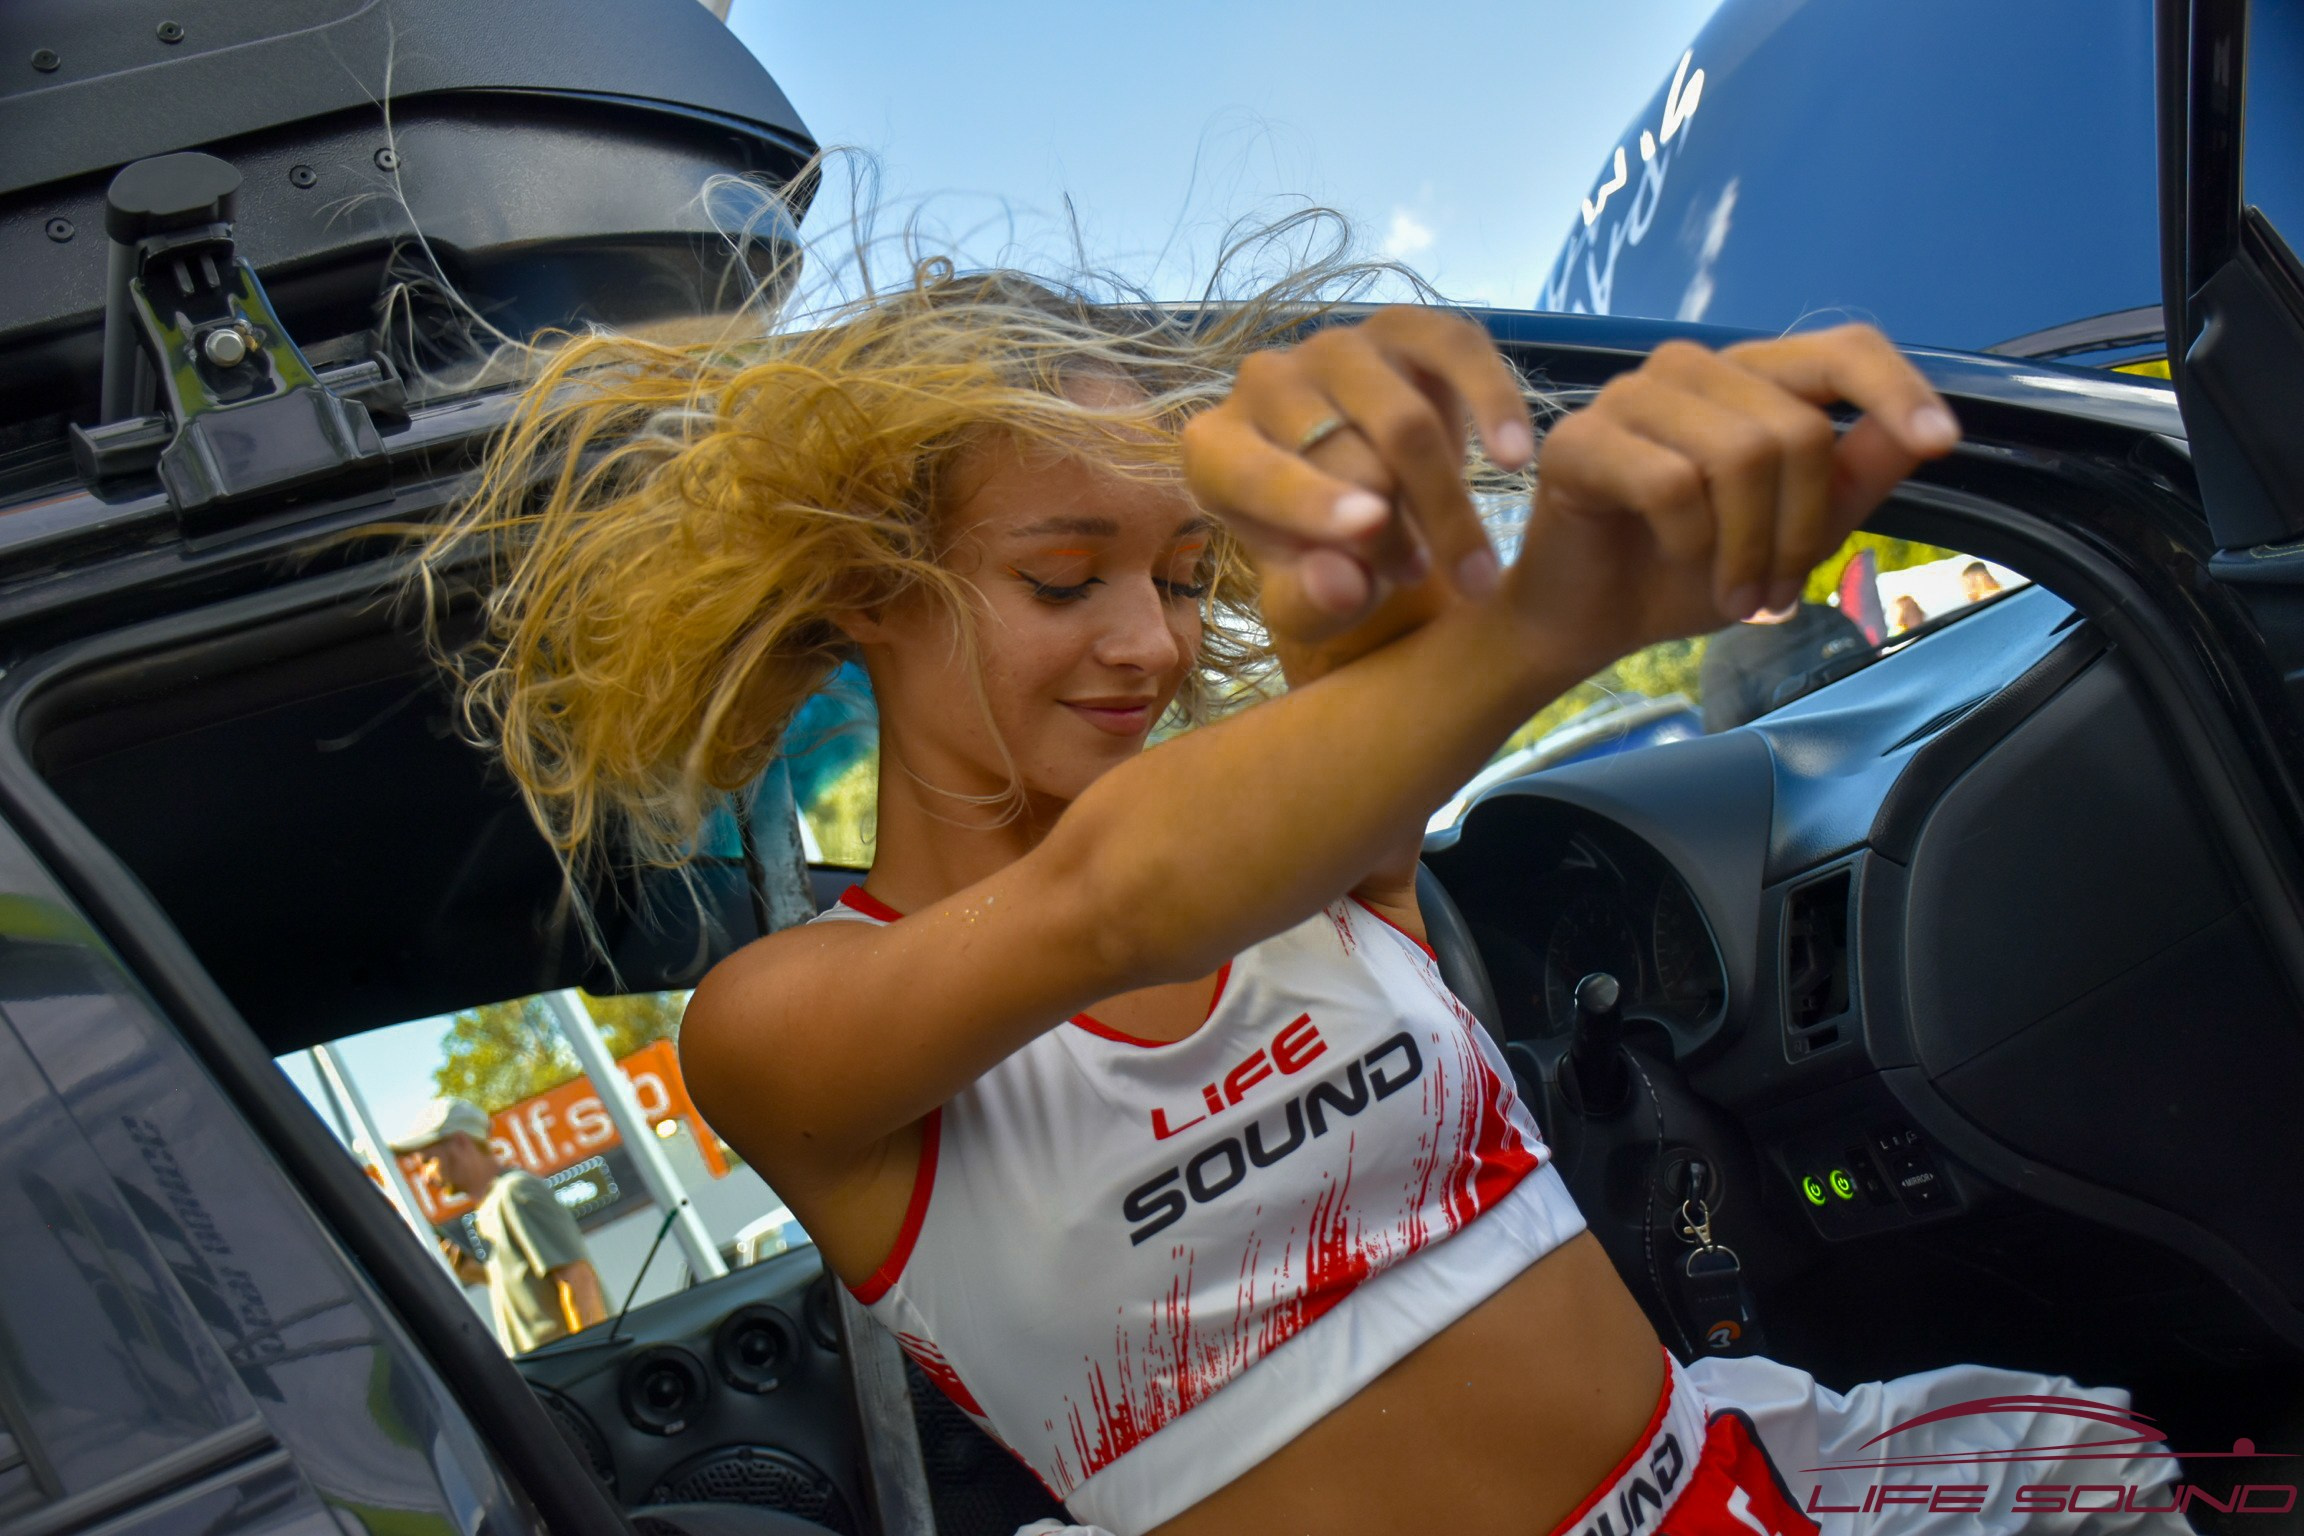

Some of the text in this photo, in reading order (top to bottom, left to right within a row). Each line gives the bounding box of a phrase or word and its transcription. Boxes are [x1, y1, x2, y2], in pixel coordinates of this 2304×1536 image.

[1123, 1031, 1423, 1246] SOUND
[1904, 1173, 1931, 1187] MIRROR
[1583, 1432, 1683, 1536] UND
